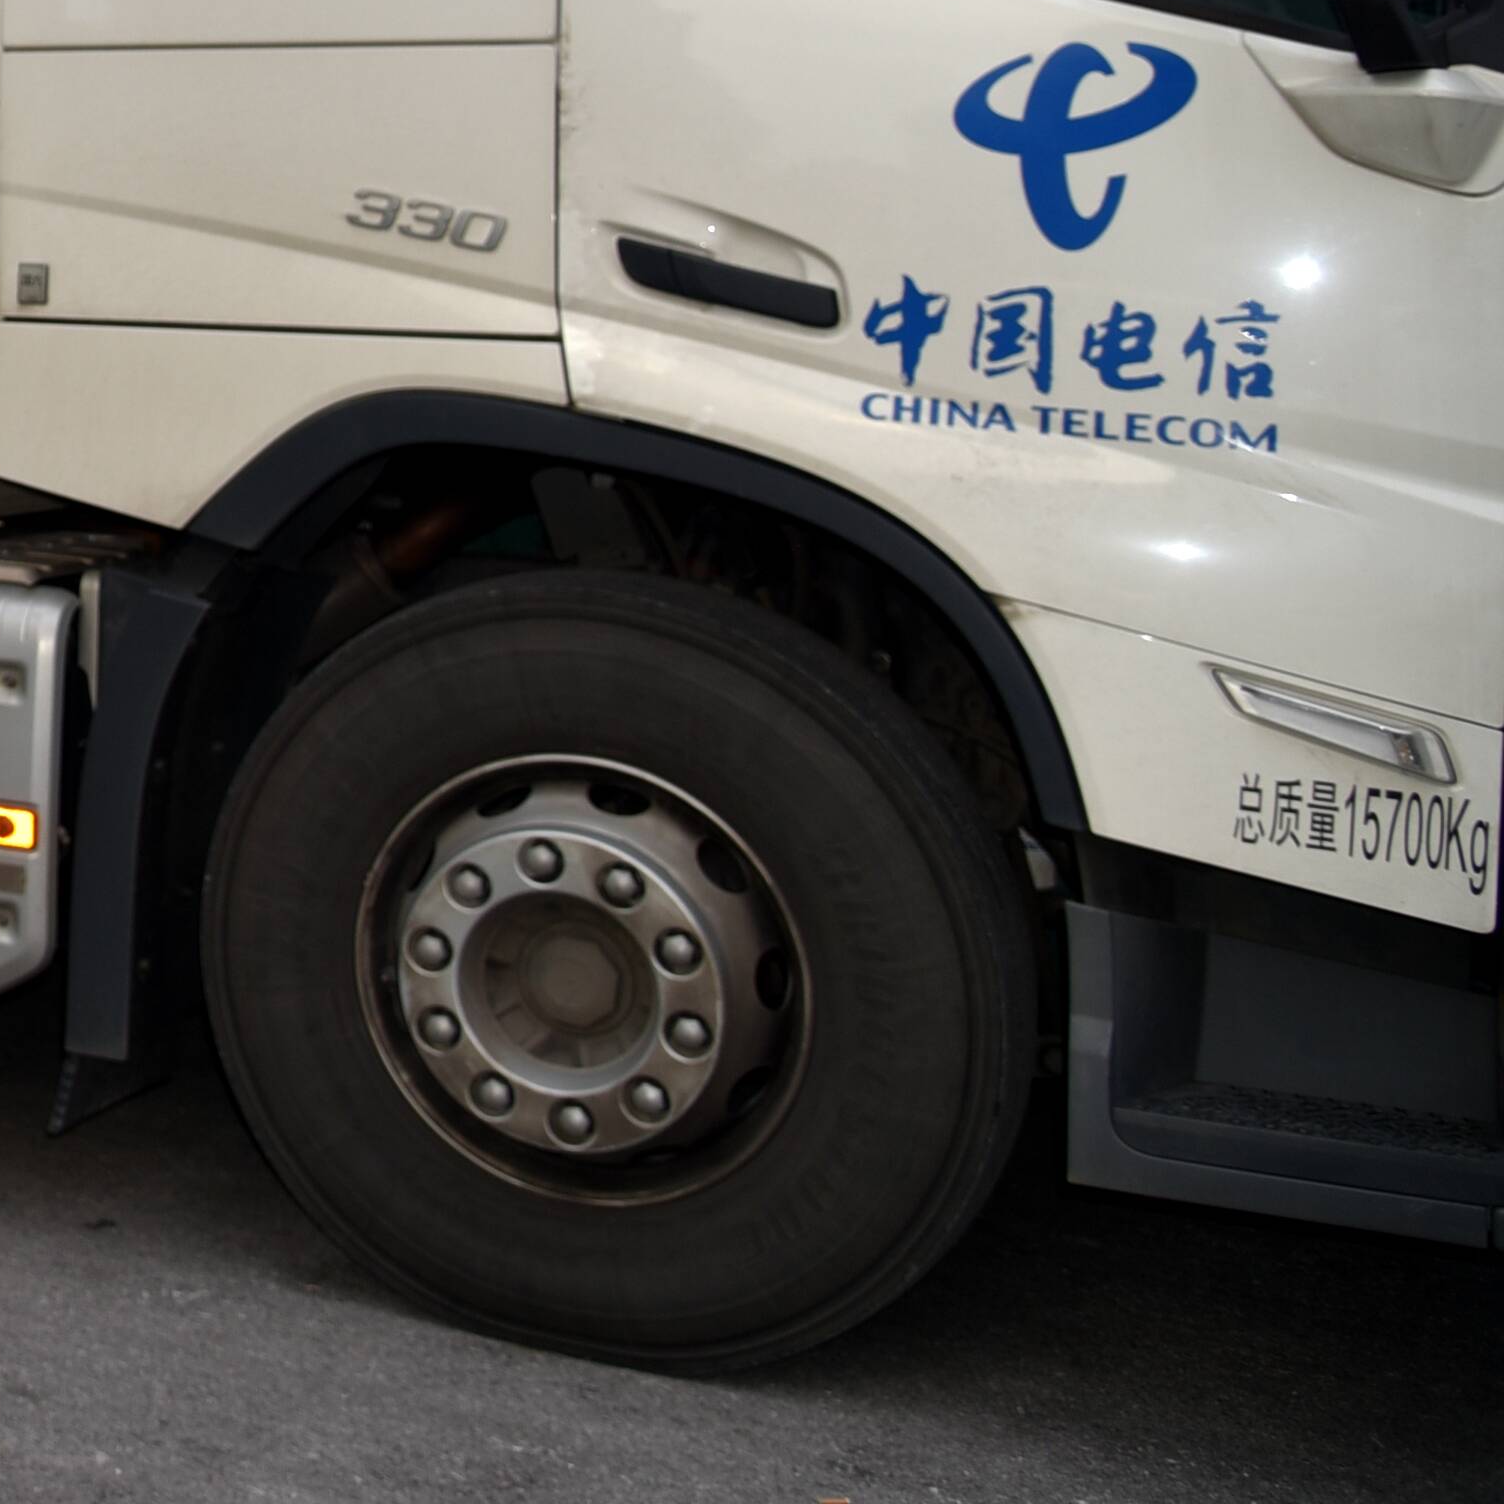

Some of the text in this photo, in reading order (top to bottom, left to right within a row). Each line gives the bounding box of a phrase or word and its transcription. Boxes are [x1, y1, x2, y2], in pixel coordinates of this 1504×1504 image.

[345, 188, 507, 254] 330
[862, 273, 1280, 401] 中国电信
[860, 392, 1278, 453] CHINA TELECOM
[1233, 772, 1490, 896] 总质量15700Kg
